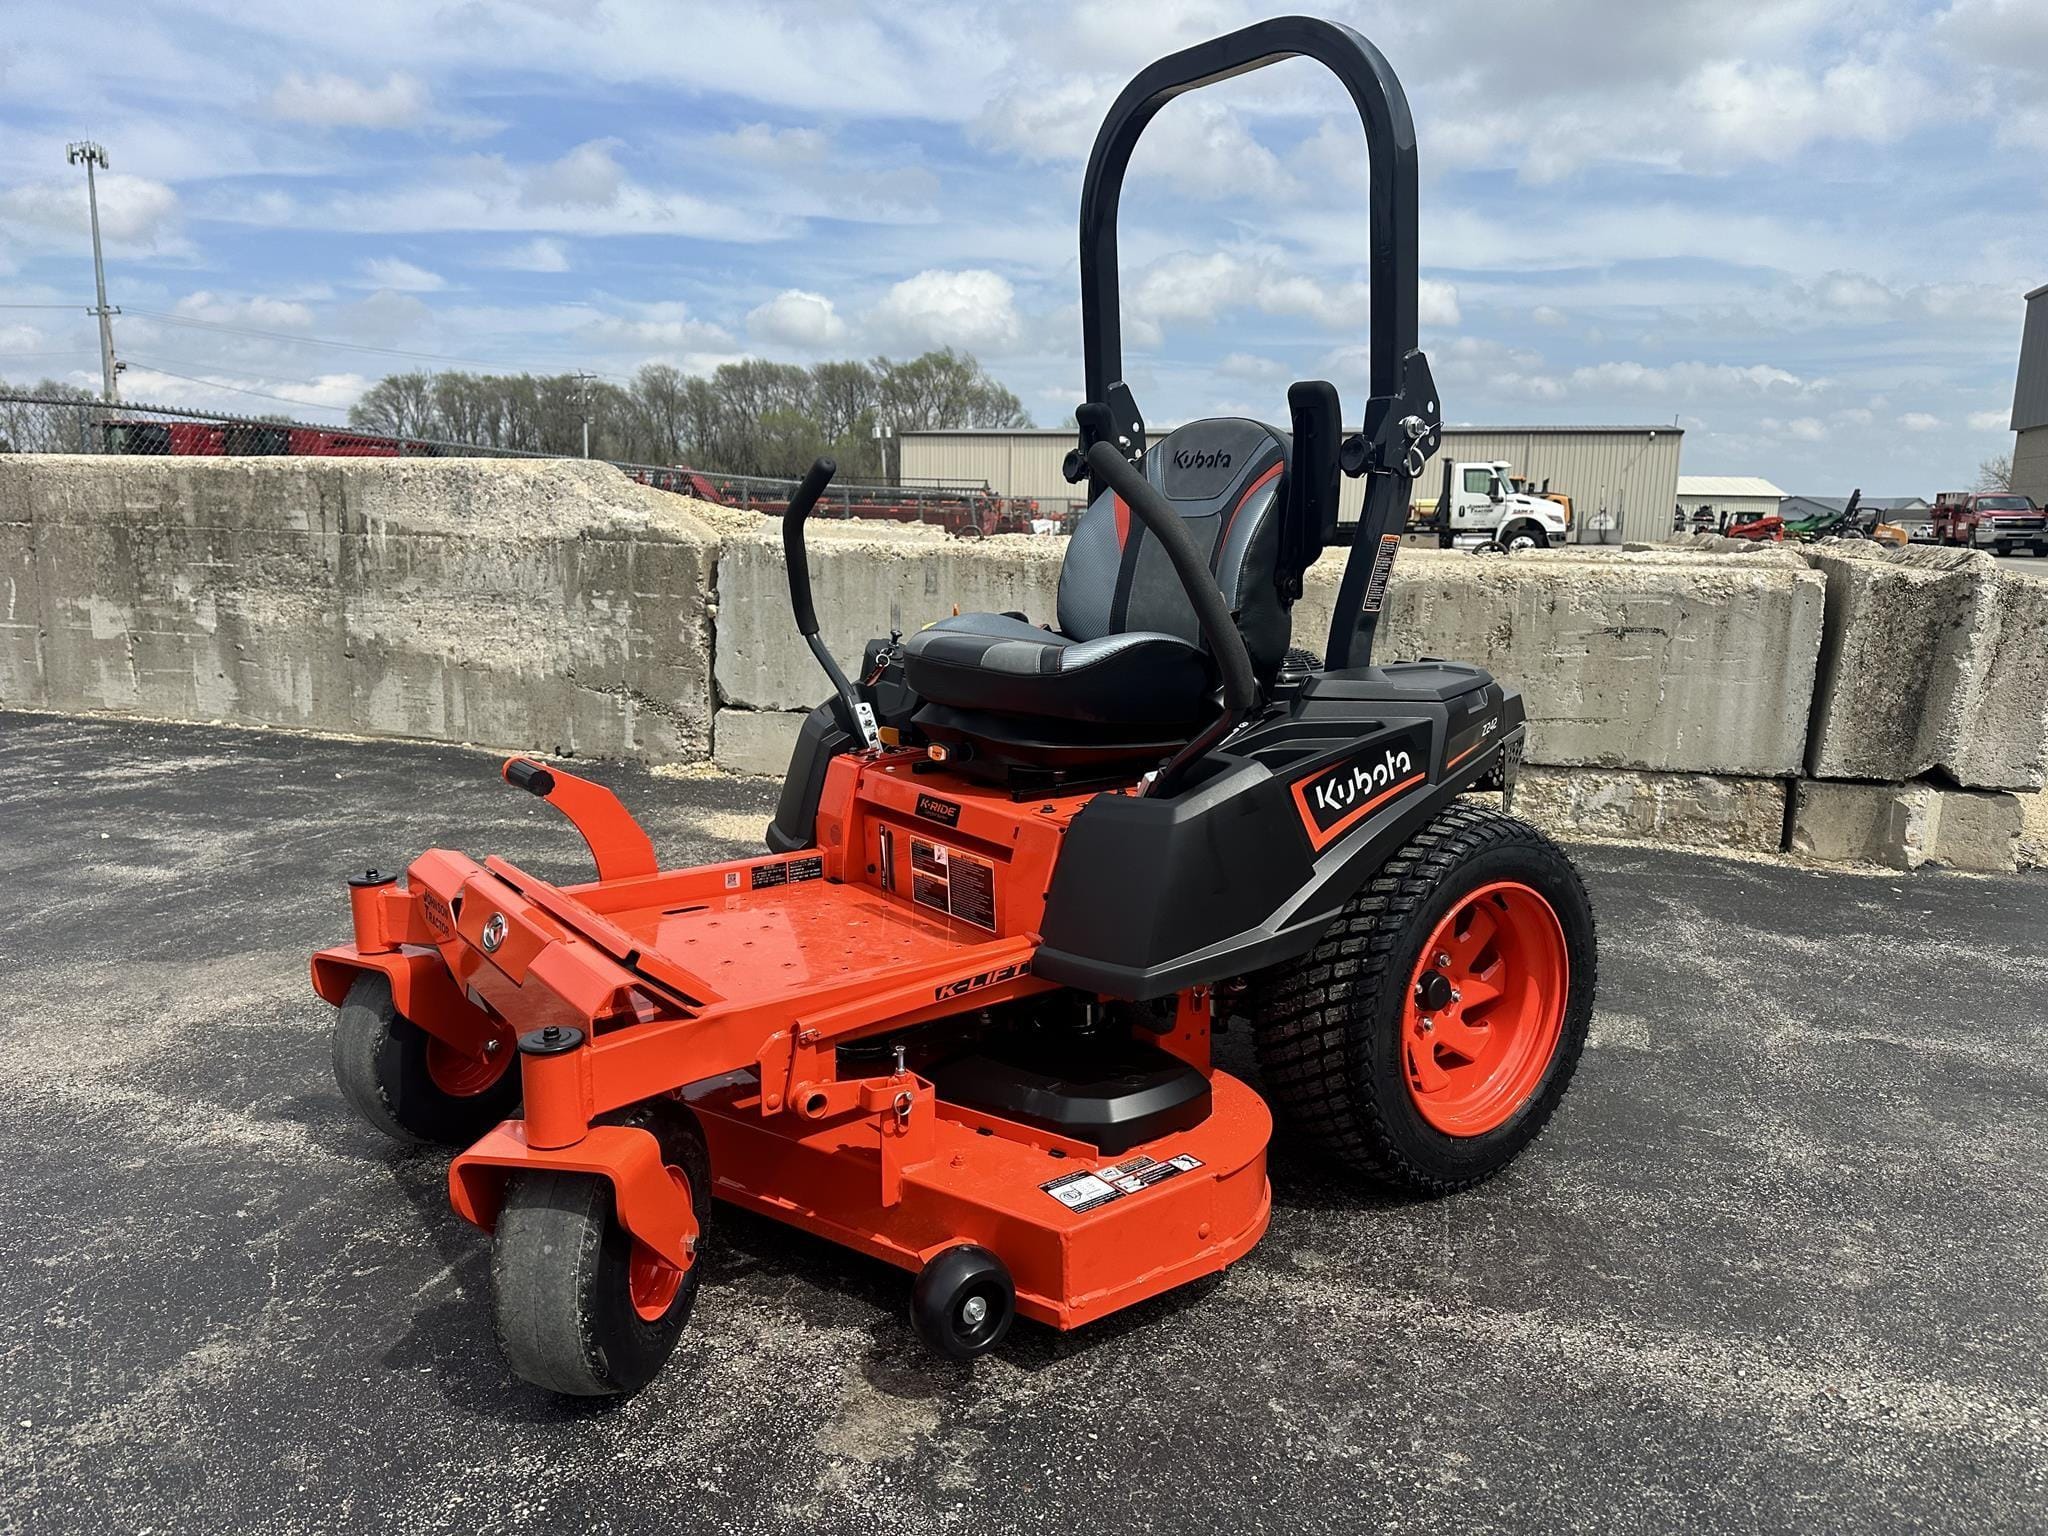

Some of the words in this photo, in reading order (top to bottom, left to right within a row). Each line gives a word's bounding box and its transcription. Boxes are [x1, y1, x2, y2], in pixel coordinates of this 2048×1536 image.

[1173, 449, 1232, 469] Kubota
[1315, 749, 1412, 810] Kubota
[423, 888, 449, 920] JOHNSON
[425, 902, 450, 938] TRACTOR
[939, 961, 1029, 999] K-LIFT
